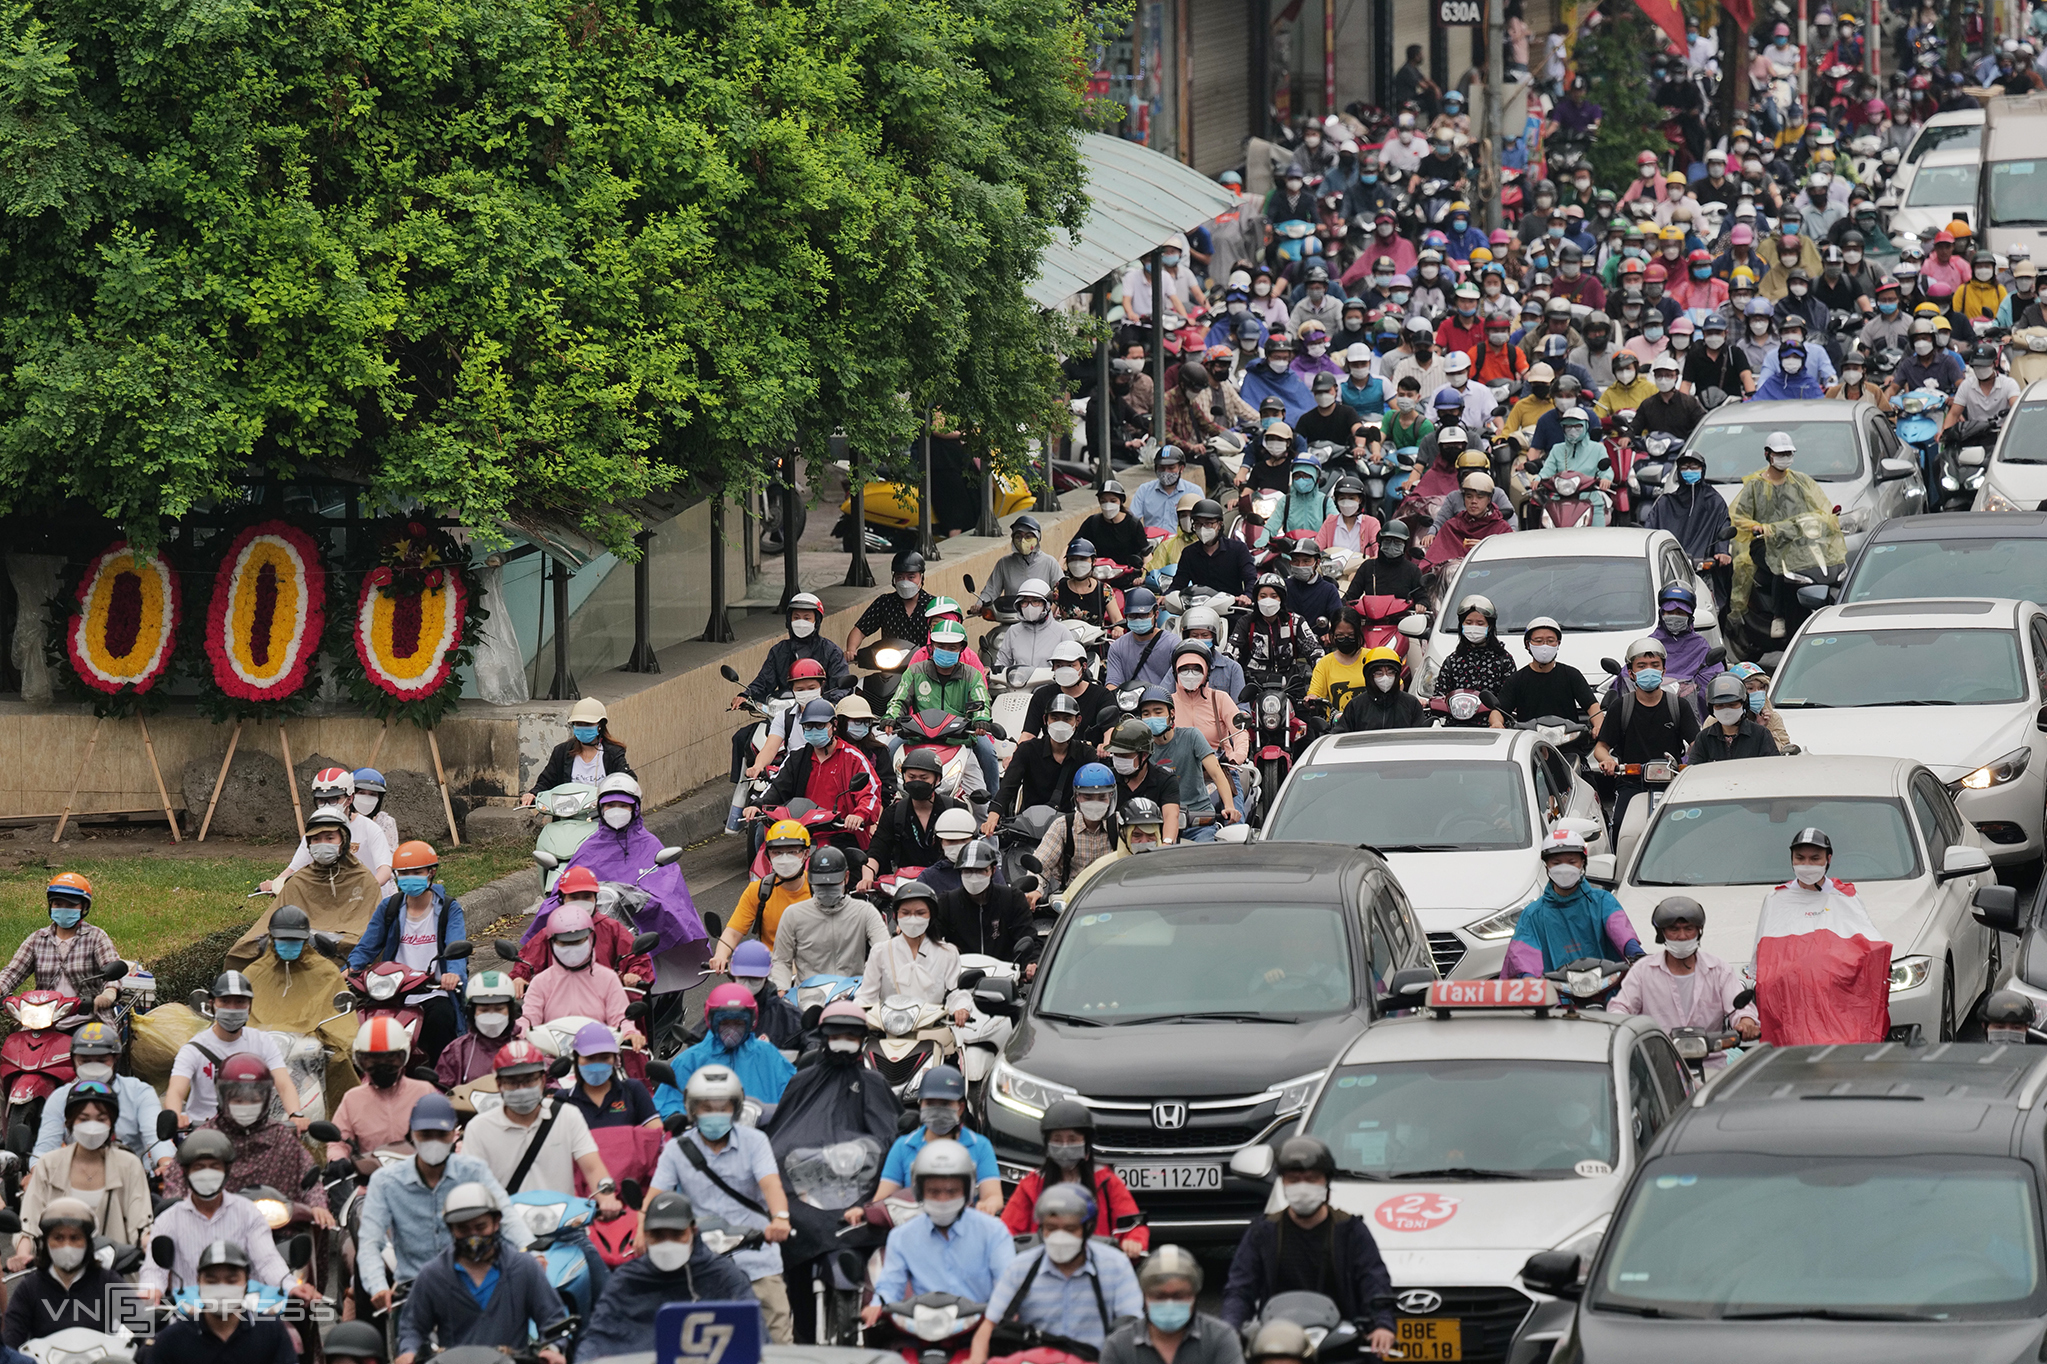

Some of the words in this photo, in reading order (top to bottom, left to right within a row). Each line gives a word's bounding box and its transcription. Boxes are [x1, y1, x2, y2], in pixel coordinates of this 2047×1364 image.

[1441, 1, 1481, 22] 630A
[1437, 980, 1485, 1002] Taxi
[1493, 979, 1545, 1002] 123
[1118, 1168, 1219, 1188] 30E-112.70
[1381, 1195, 1463, 1223] 123
[1396, 1217, 1429, 1229] Taxi
[1401, 1322, 1437, 1339] 88E
